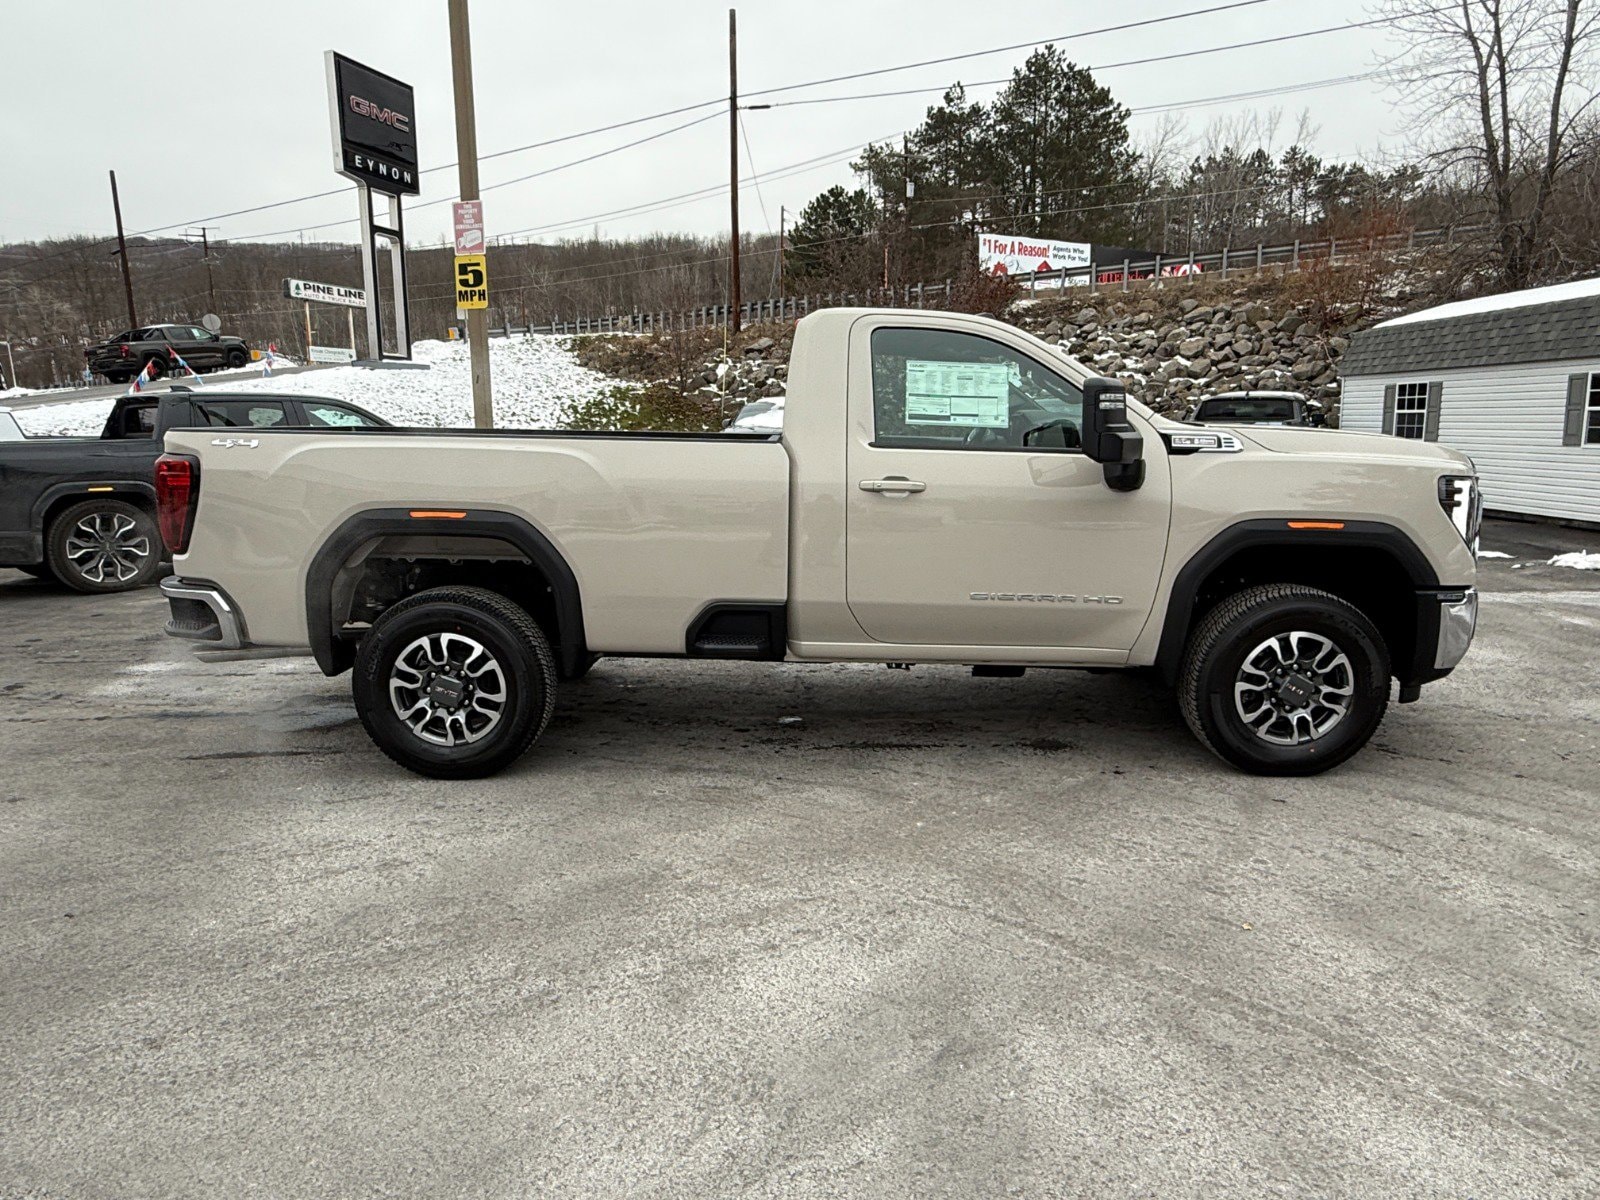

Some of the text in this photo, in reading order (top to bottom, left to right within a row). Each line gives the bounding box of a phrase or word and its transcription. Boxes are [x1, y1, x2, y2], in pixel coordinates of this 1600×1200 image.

[350, 95, 409, 133] GMC
[354, 154, 412, 184] EYNON
[994, 239, 1008, 255] For
[1010, 241, 1016, 256] A
[1018, 242, 1050, 258] Reason!
[1053, 245, 1085, 255] Agents Who
[1068, 254, 1077, 262] For
[458, 262, 484, 288] 5
[303, 282, 365, 300] PINE LINE
[458, 289, 487, 302] MPH
[969, 591, 1124, 605] SIERRA HD
